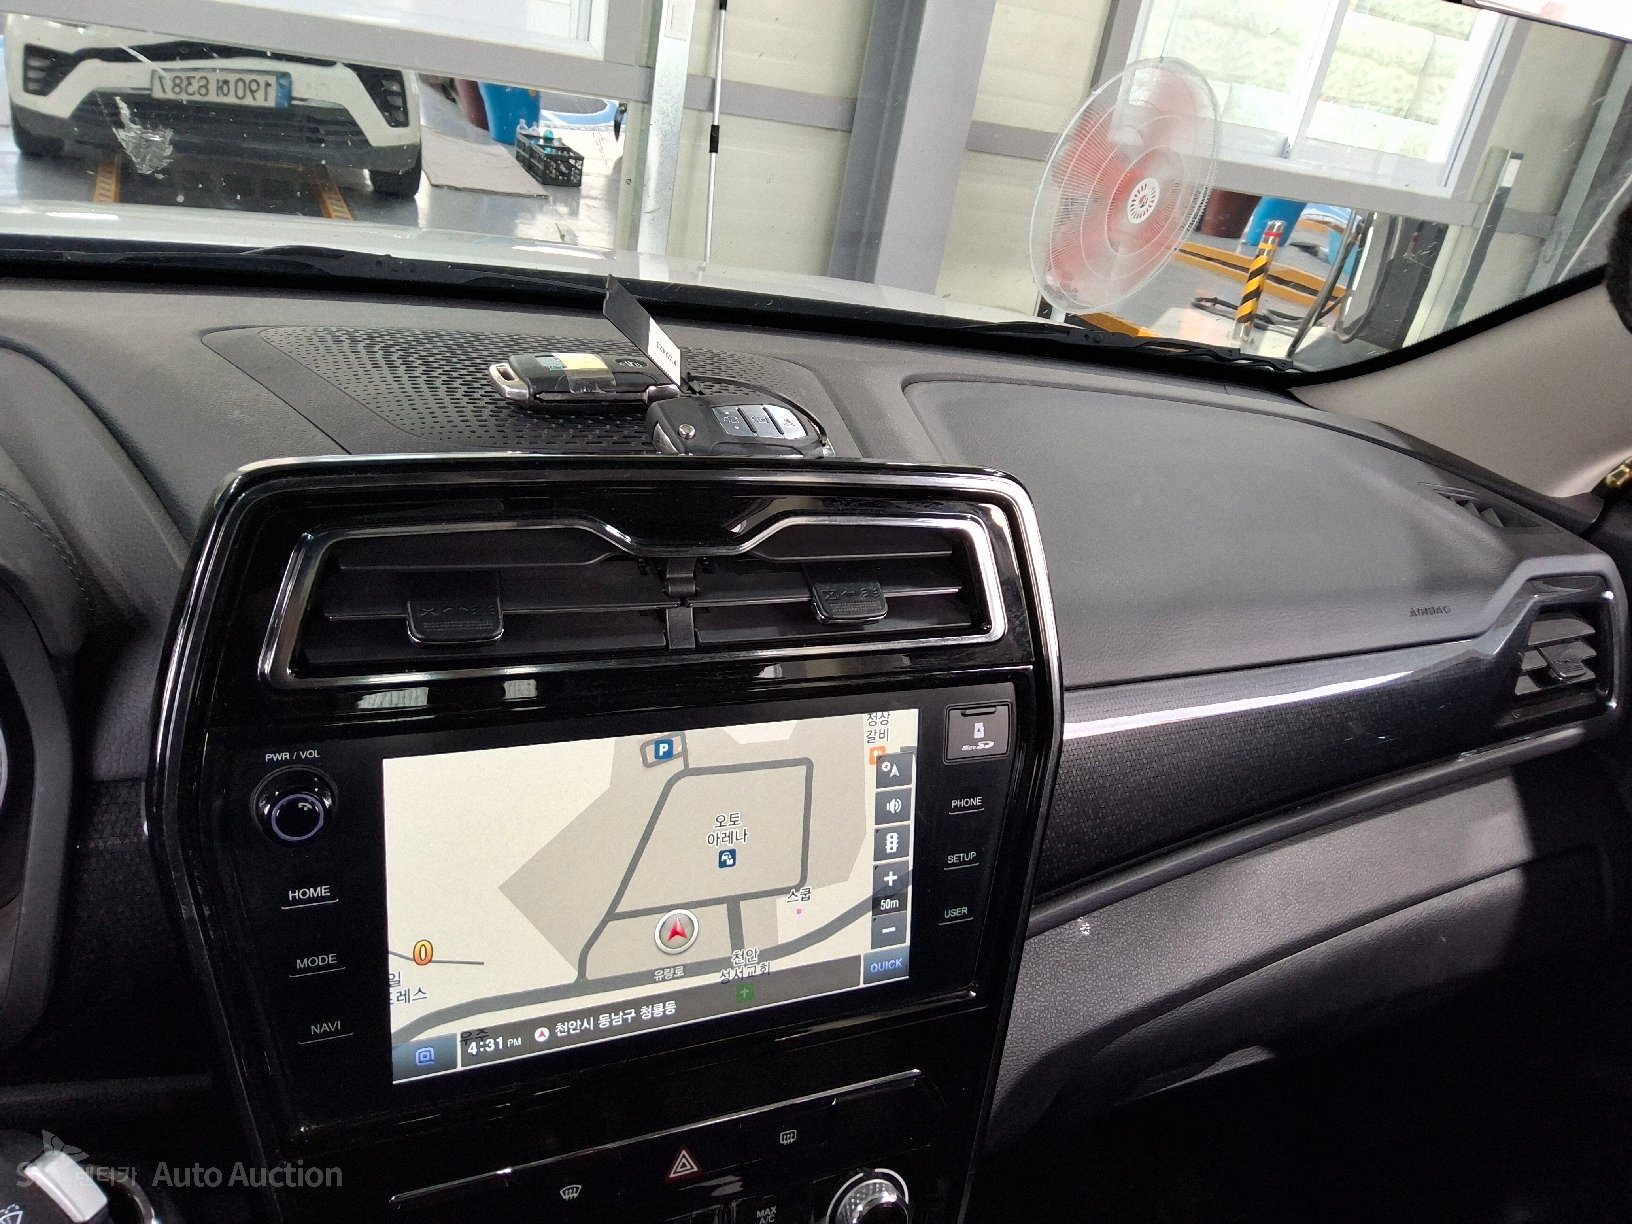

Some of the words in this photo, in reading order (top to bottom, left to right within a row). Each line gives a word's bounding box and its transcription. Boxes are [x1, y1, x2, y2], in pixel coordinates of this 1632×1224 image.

[1409, 605, 1452, 617] AIRBAG
[865, 728, 889, 744] 갈비
[265, 751, 290, 763] PWR
[299, 749, 321, 759] VOL
[951, 796, 984, 809] PHONE
[713, 812, 742, 829] 오토
[706, 829, 749, 848] 아레나
[947, 851, 978, 864] SETUP
[288, 885, 332, 901] HOME
[786, 886, 811, 904] 스쿱
[880, 898, 900, 911] 50m
[944, 906, 969, 919] USER
[296, 952, 338, 970] MODE
[731, 947, 760, 966] 천안
[870, 958, 904, 973] QUICK
[554, 1017, 595, 1037] 천안시
[597, 1009, 637, 1029] 동남구
[639, 1000, 677, 1021] 청룡동
[310, 1020, 343, 1036] NAVI
[466, 1036, 505, 1056] 4:31
[507, 1036, 523, 1049] PM
[756, 1206, 778, 1219] MAX
